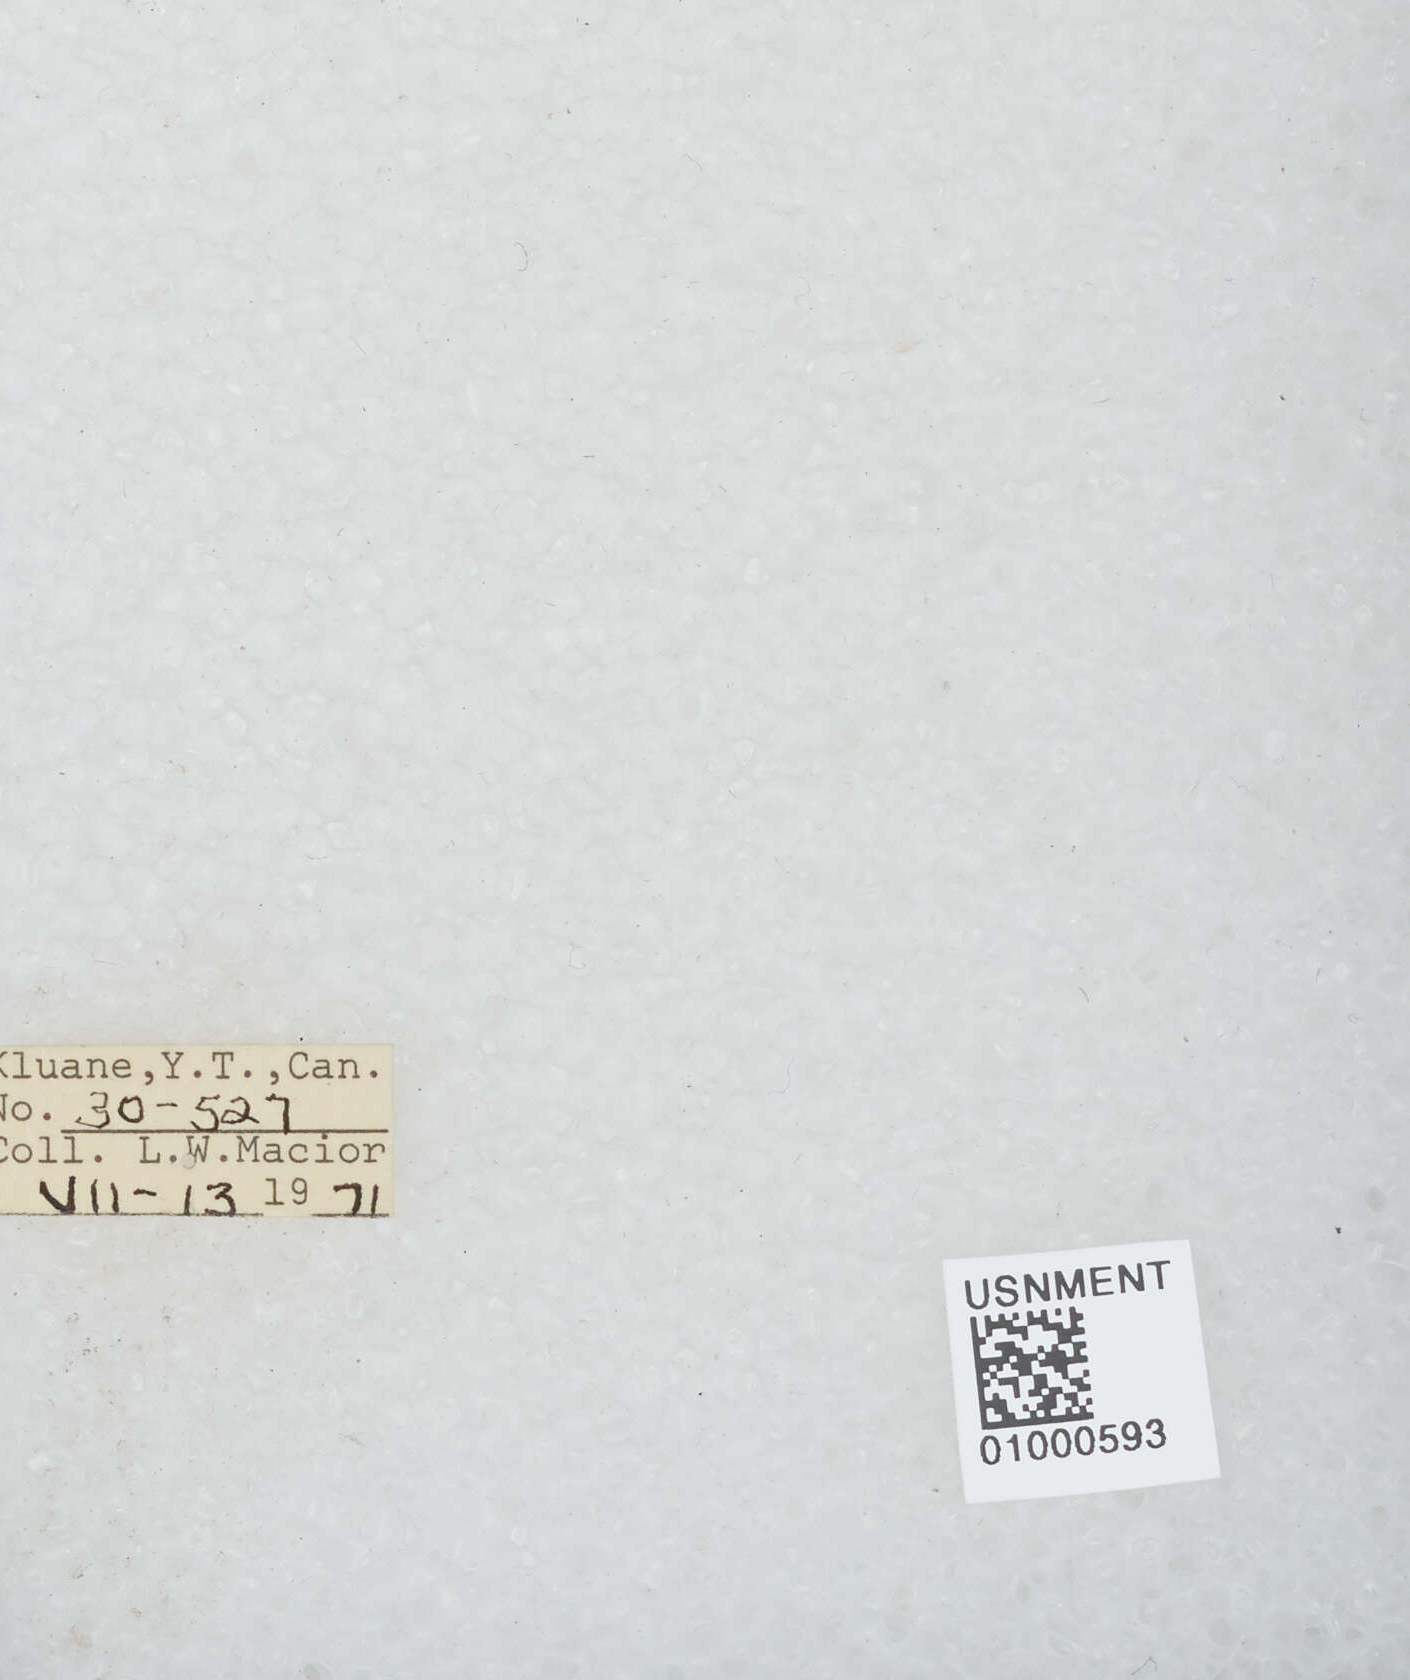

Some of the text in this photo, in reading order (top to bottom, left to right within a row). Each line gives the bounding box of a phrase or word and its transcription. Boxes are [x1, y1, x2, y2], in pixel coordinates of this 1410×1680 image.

[75, 1091, 290, 1133] 30-527
[964, 1260, 1171, 1310] USNMENT
[979, 1418, 1167, 1466] 01000593
